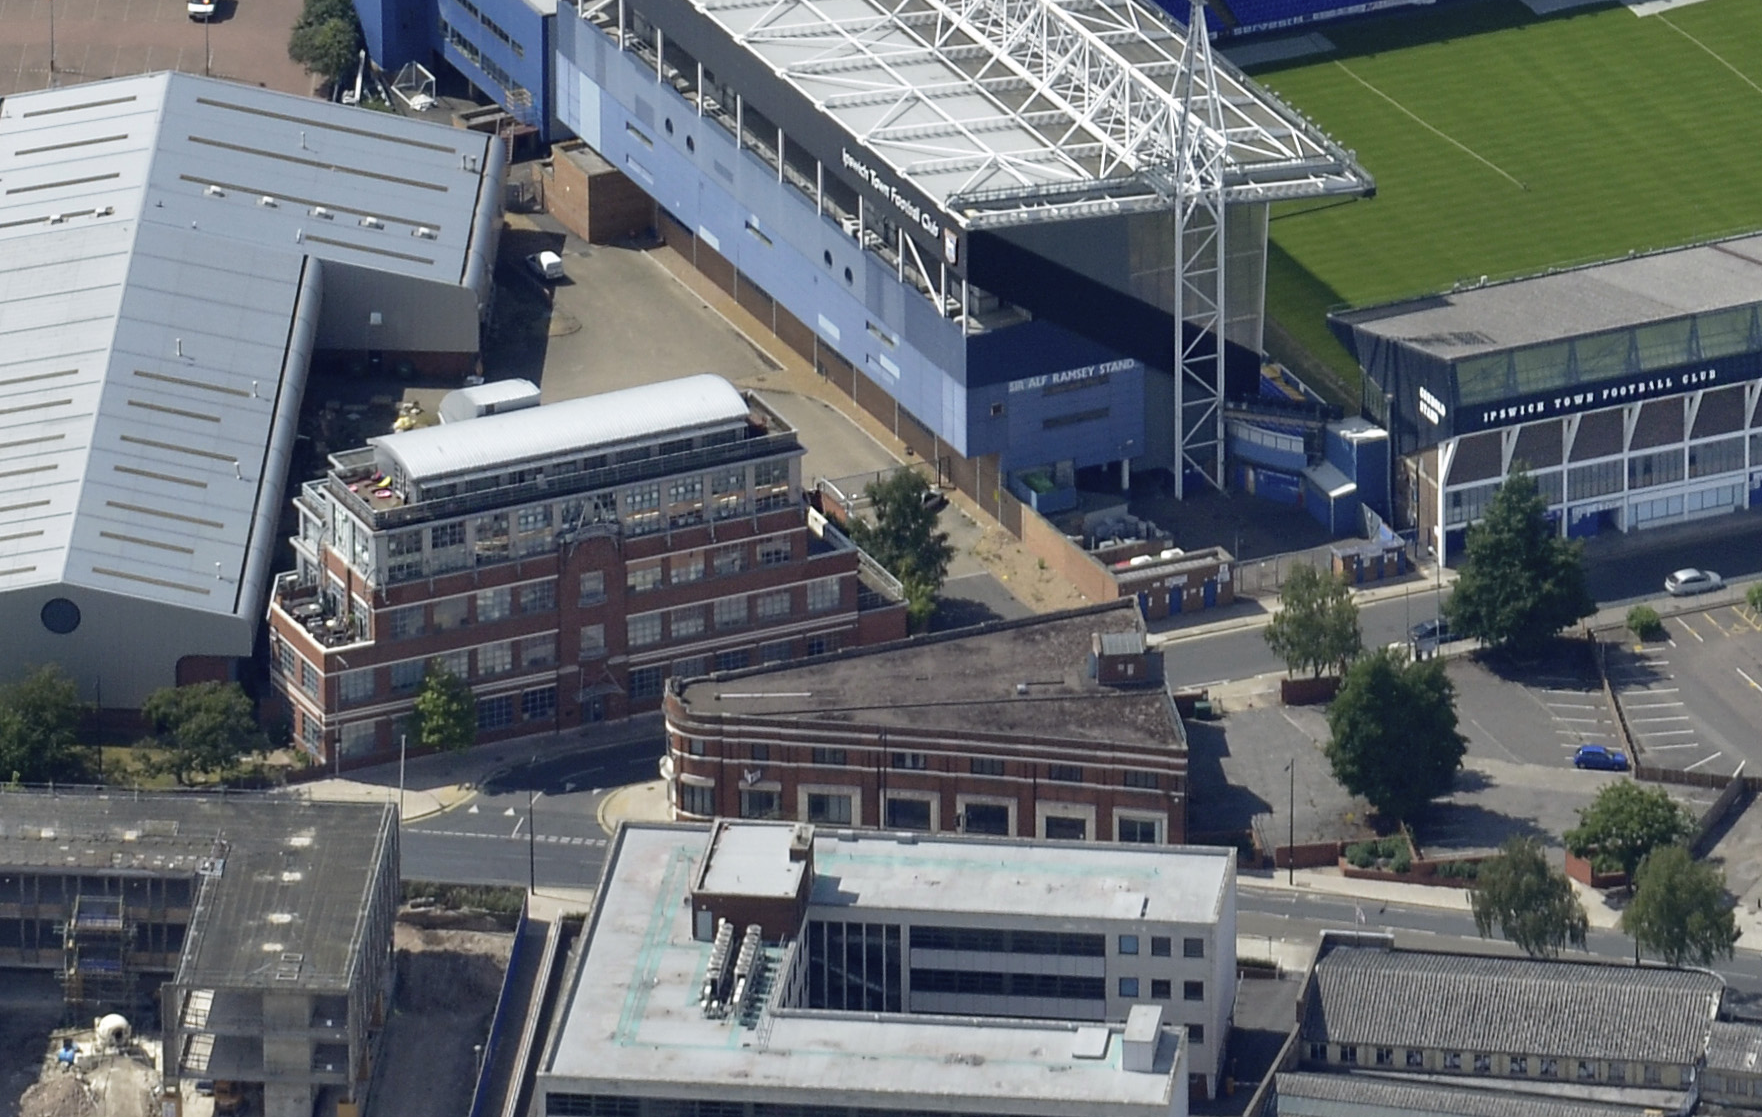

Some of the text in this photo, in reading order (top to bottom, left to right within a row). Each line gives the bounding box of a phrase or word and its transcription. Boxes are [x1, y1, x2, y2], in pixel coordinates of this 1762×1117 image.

[842, 147, 939, 237] Ipswich Town Football Club
[1009, 358, 1135, 393] SIR ALF RAMSEY STAND
[1483, 369, 1716, 422] IPSWICH TOWN FOOTBALL CLUB
[1420, 400, 1439, 425] STAND
